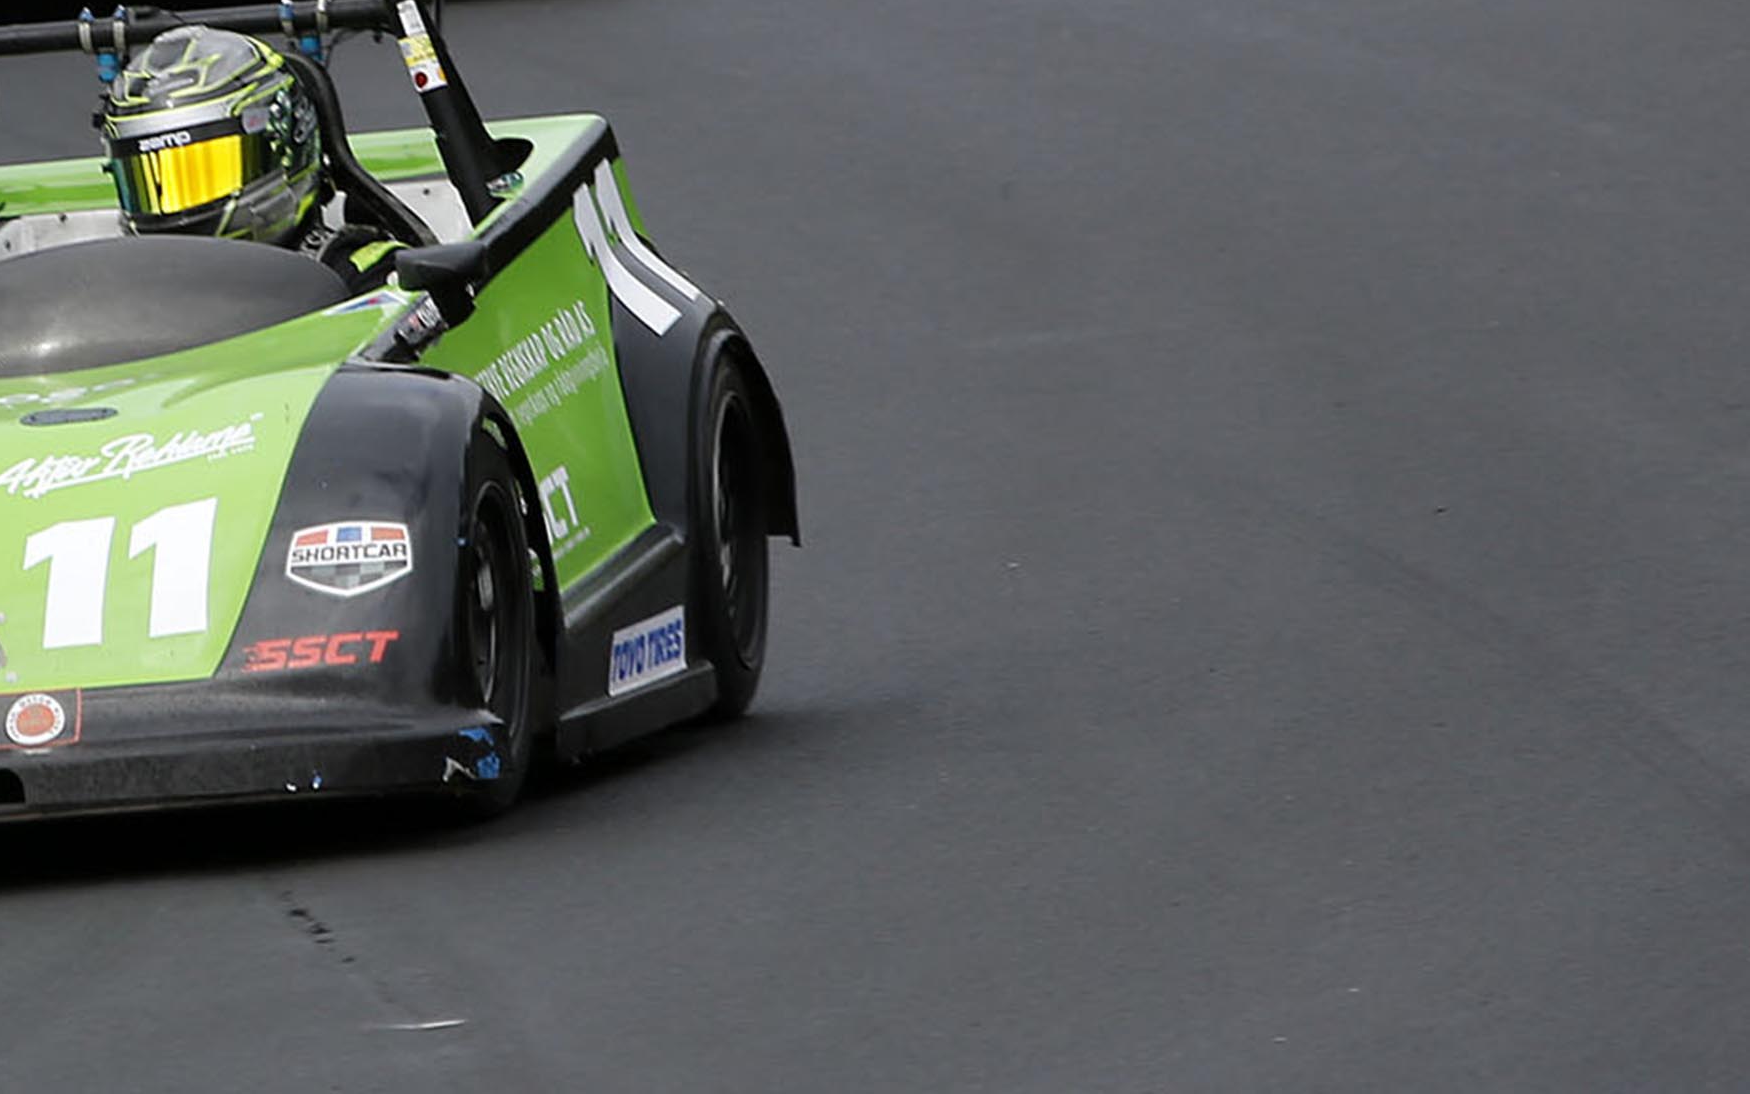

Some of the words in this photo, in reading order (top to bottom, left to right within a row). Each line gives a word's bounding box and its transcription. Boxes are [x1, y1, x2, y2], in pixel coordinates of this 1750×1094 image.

[22, 497, 217, 649] 11
[290, 542, 408, 563] SHORTCAR
[612, 637, 646, 683] TOYO
[648, 619, 683, 668] TIRES
